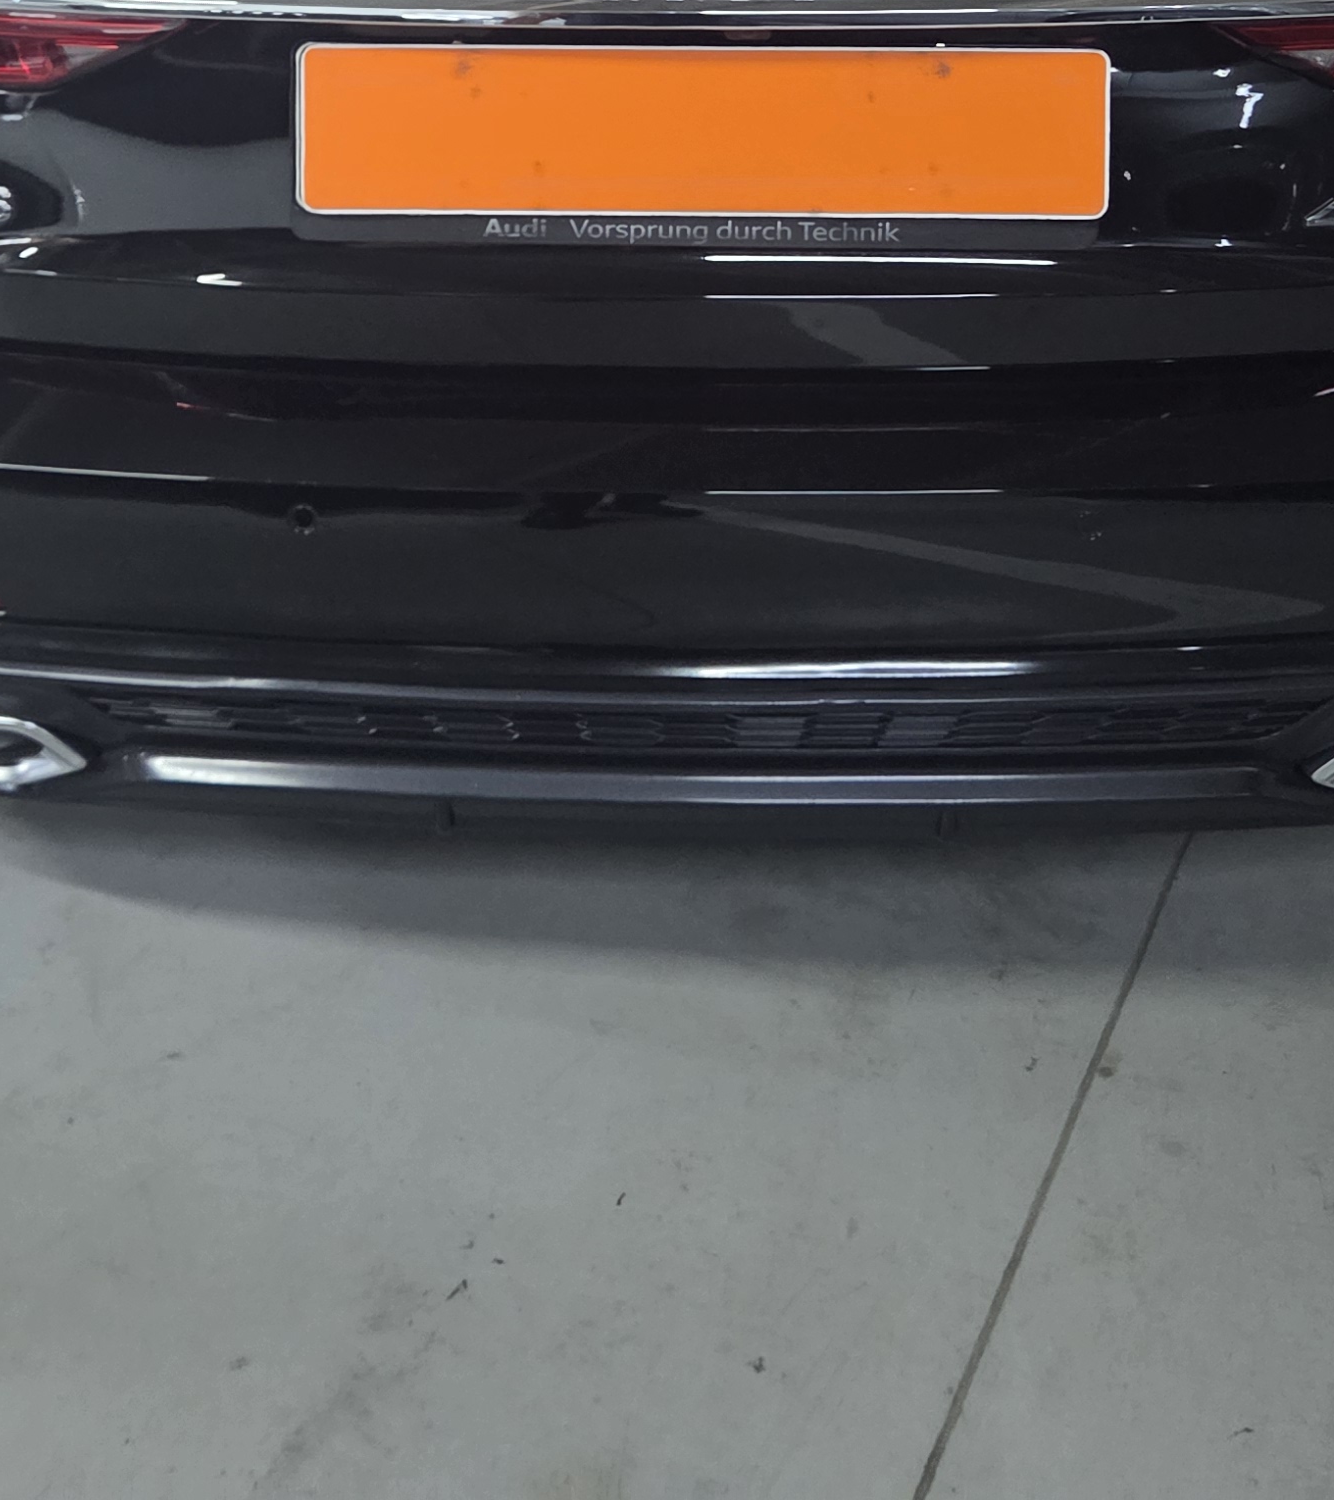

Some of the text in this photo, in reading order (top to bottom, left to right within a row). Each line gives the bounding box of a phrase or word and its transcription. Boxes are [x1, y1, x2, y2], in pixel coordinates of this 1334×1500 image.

[483, 218, 900, 245] Audi Vorsprung durch Technik
